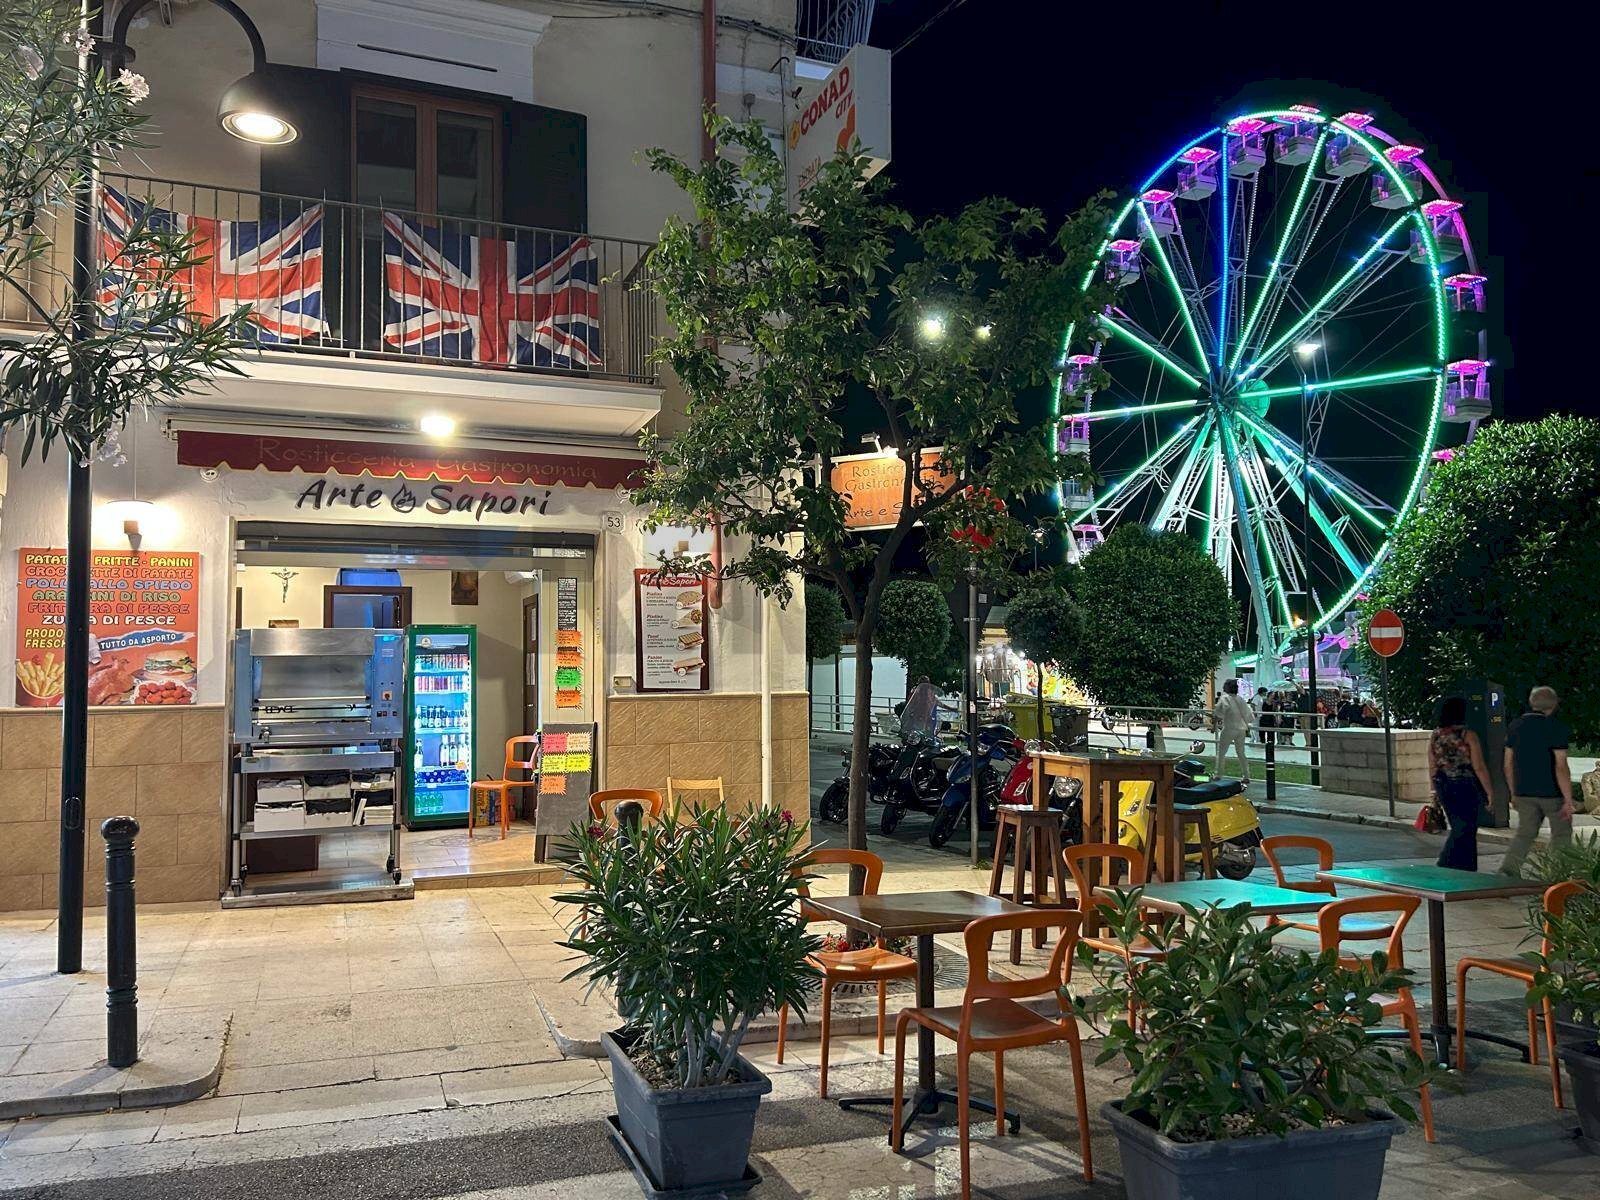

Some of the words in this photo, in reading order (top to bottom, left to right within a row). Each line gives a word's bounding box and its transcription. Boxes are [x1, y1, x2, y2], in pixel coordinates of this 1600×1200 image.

[800, 66, 850, 136] CONAD
[835, 89, 854, 119] CITY
[255, 437, 416, 468] Rosticceria
[434, 452, 598, 480] Gastronomia
[295, 479, 383, 511] Arte
[425, 484, 552, 522] Sapori
[606, 516, 621, 528] 53
[25, 554, 68, 565] PATAT
[94, 556, 140, 567] FRITTE
[150, 557, 193, 567] PANINI
[123, 568, 138, 578] DI
[141, 568, 193, 579] PATATE
[26, 578, 68, 589] POLL
[133, 580, 192, 591] SPIEDO
[121, 591, 137, 602] DI
[142, 592, 181, 602] RISO
[28, 602, 112, 614] FRITRA
[115, 603, 134, 614] DI
[138, 604, 190, 614] PESCE
[42, 615, 97, 625] ZUA
[103, 616, 119, 625] DI
[125, 616, 176, 626] PESCE
[25, 628, 64, 638] PRODO
[101, 640, 126, 650] TUTTO
[128, 638, 139, 646] DA
[141, 633, 177, 644] ASPORTO
[1491, 692, 1499, 707] P
